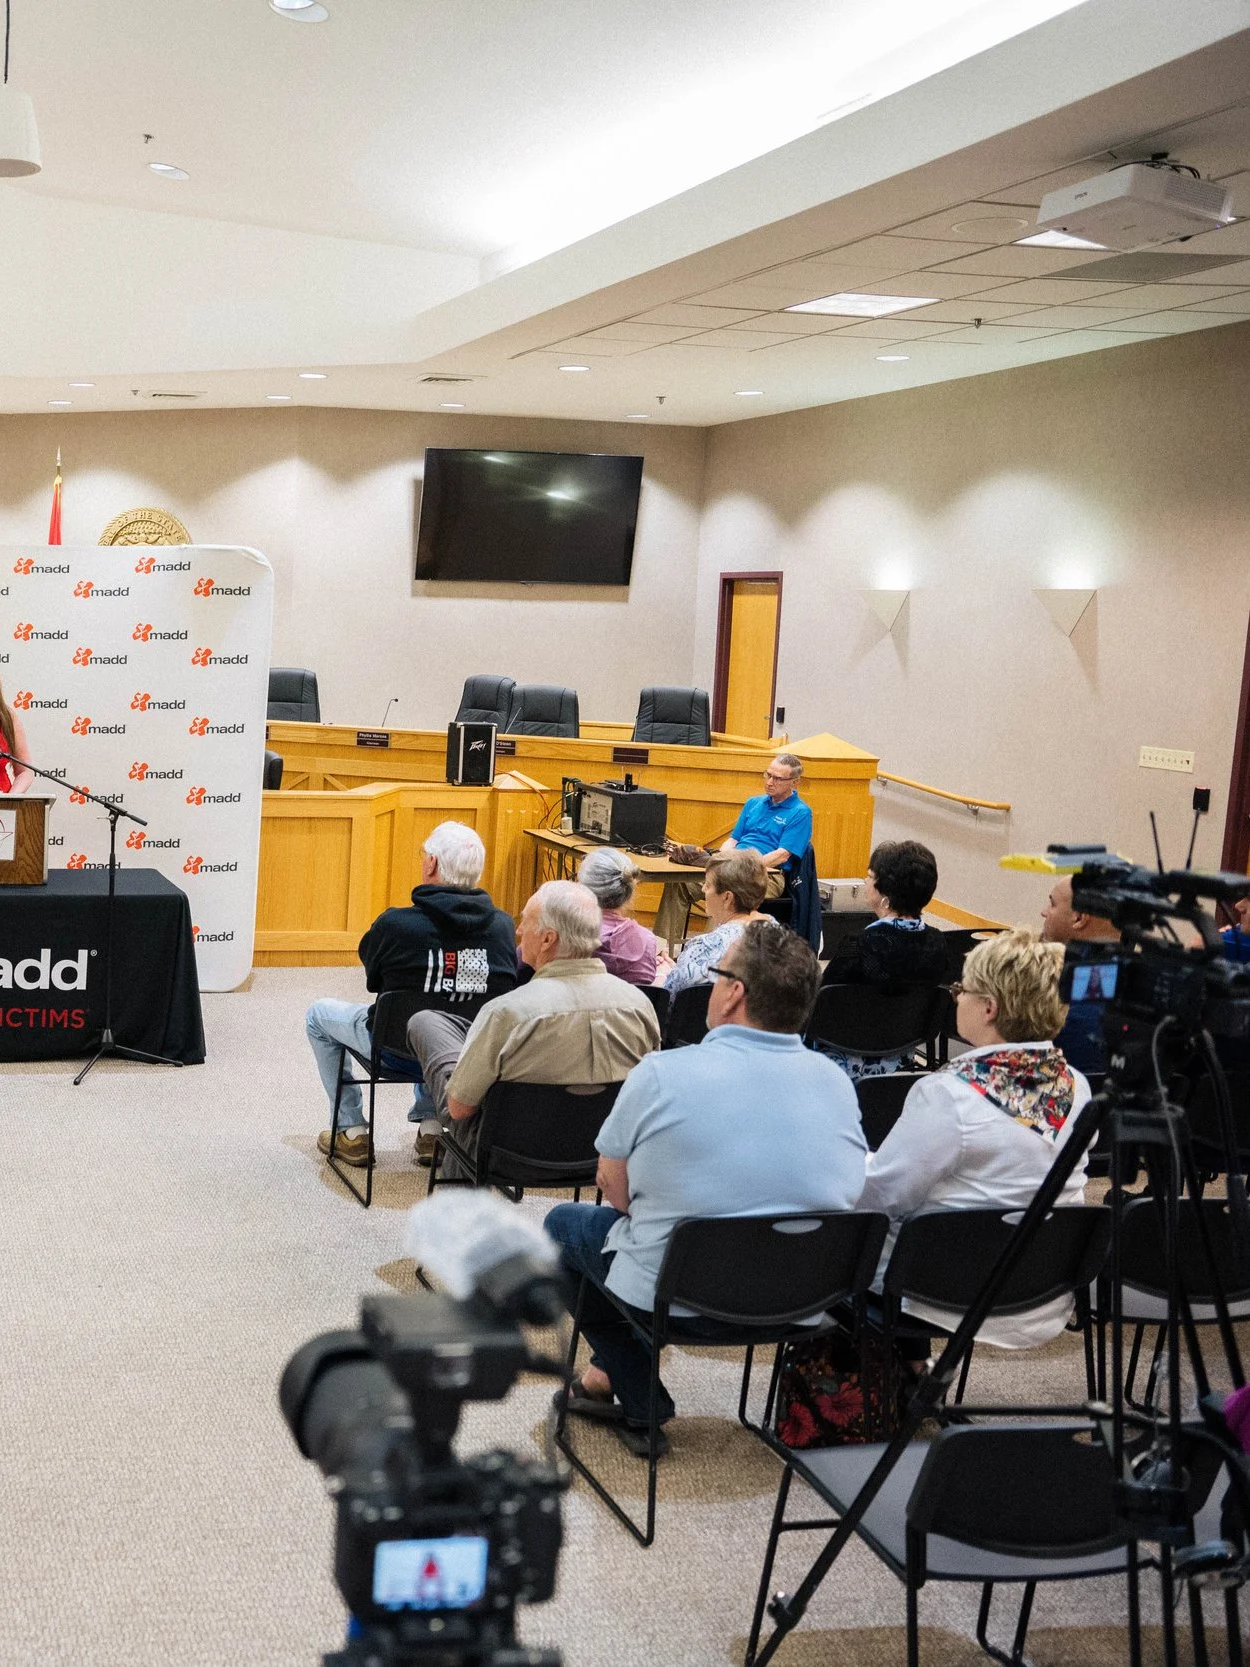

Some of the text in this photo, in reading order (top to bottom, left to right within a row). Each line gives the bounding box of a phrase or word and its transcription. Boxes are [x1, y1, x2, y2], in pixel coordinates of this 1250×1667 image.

[31, 564, 69, 574] madd
[152, 561, 190, 572] madd
[90, 587, 129, 597] madd
[211, 585, 250, 596] madd
[30, 629, 68, 640] madd
[149, 629, 187, 641] madd
[89, 654, 127, 665] madd
[208, 654, 248, 665] madd
[30, 698, 67, 709] madd
[147, 699, 185, 710] madd
[88, 724, 125, 735] madd
[206, 723, 244, 734] madd
[145, 768, 183, 780] madd
[203, 792, 240, 804] madd
[47, 835, 64, 846] dd
[142, 838, 180, 849] madd
[199, 861, 237, 873] madd
[196, 930, 234, 942] madd
[444, 951, 457, 976] BIG
